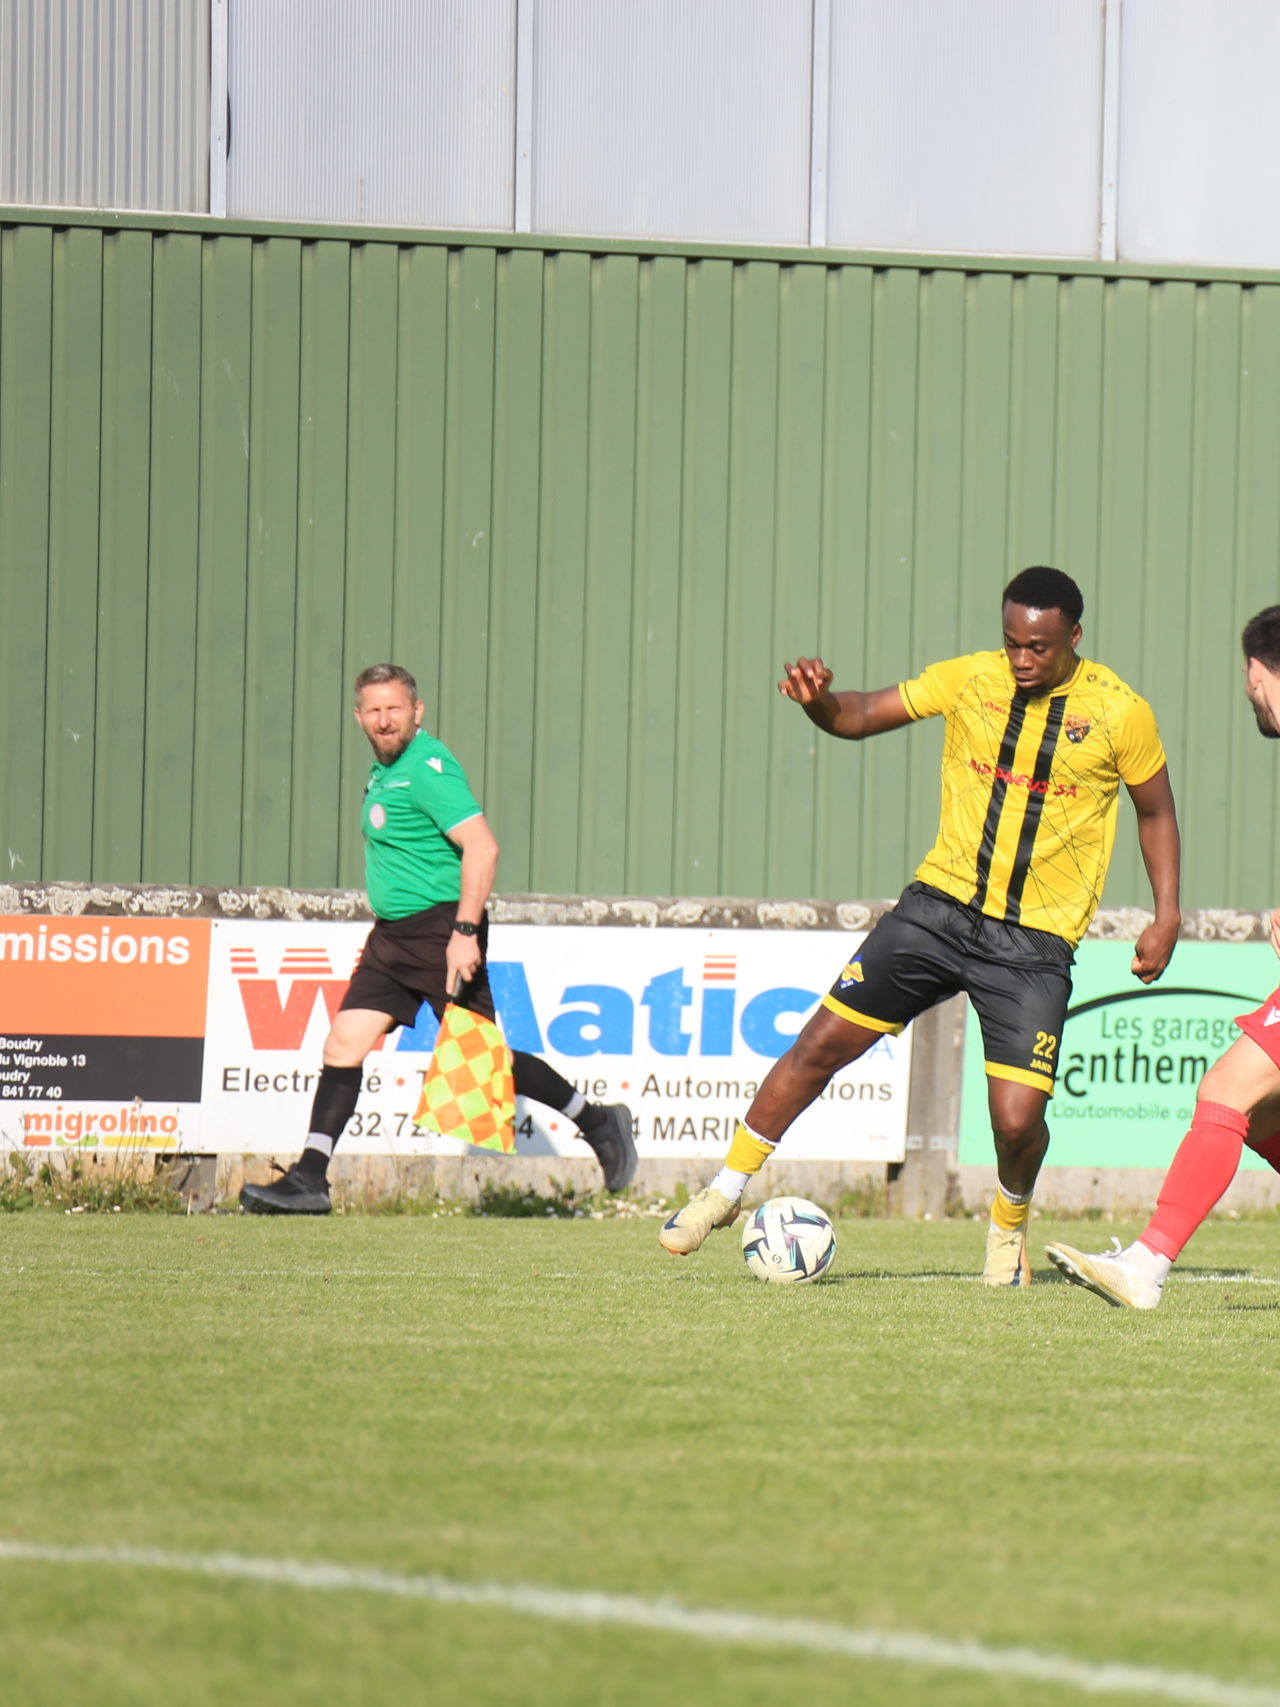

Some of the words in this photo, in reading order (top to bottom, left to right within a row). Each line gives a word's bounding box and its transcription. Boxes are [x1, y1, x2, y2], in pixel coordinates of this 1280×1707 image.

[0, 924, 190, 966] missions
[1101, 1011, 1143, 1040] Les
[1152, 1017, 1242, 1048] garage
[0, 1037, 43, 1053] Boudry
[1033, 1031, 1056, 1060] 22
[13, 1053, 68, 1068] Vignoble
[71, 1055, 87, 1067] 13
[0, 1069, 31, 1085] udry
[2, 1085, 24, 1098] 841
[28, 1086, 44, 1098] 77
[46, 1086, 63, 1099] 40
[24, 1105, 178, 1140] migrolino
